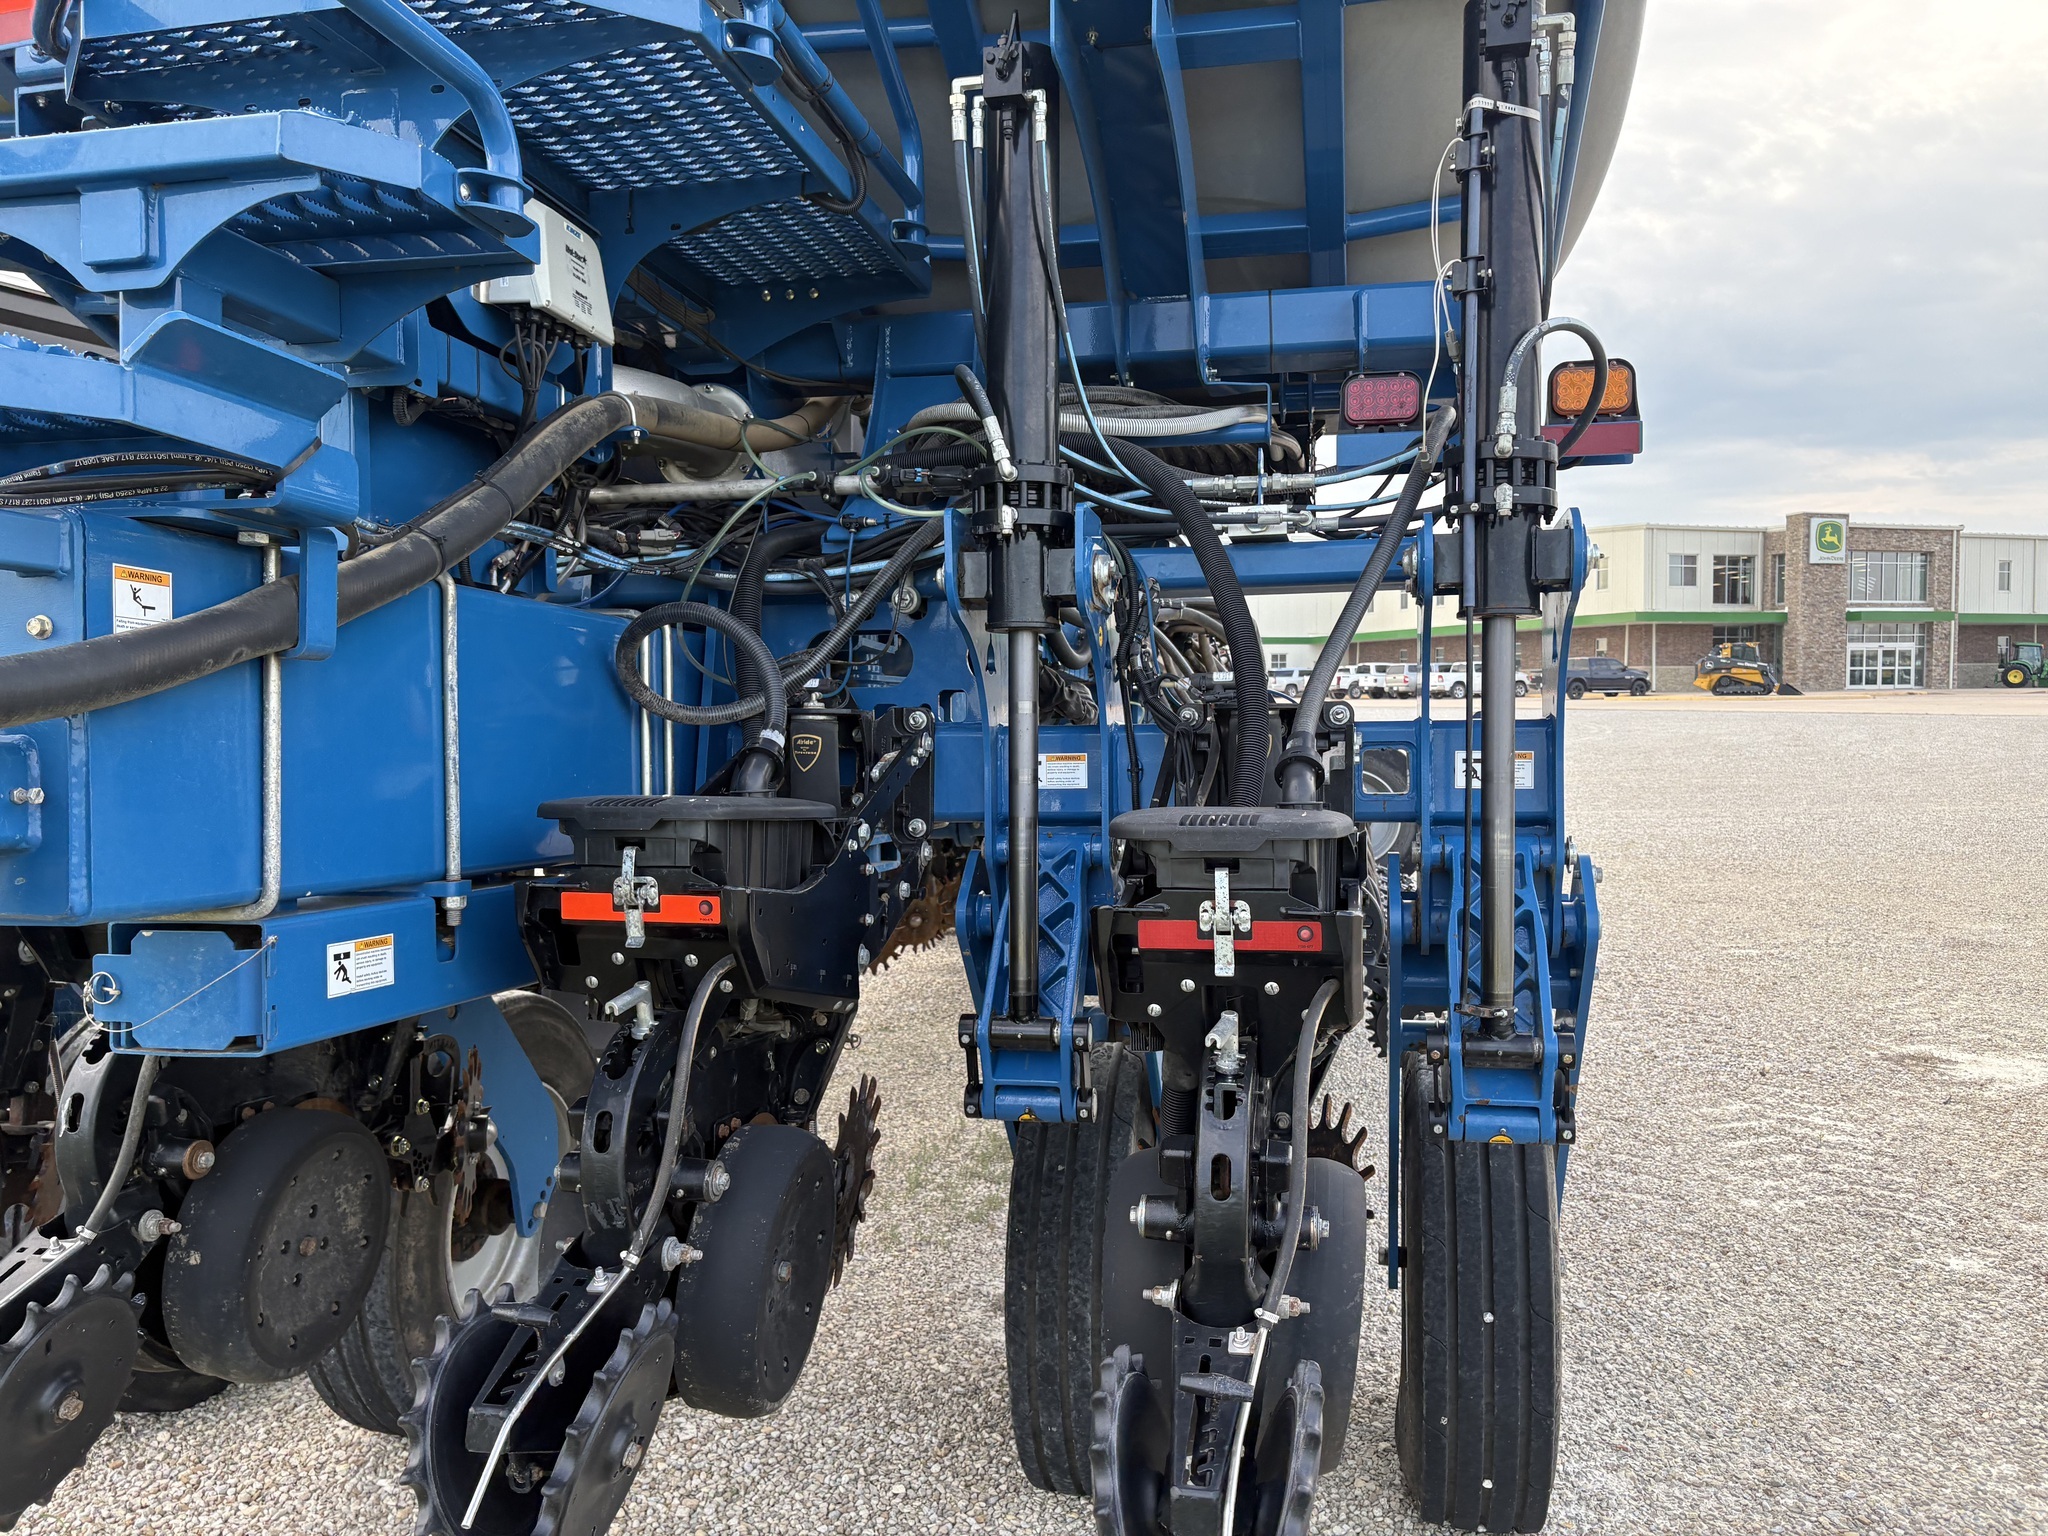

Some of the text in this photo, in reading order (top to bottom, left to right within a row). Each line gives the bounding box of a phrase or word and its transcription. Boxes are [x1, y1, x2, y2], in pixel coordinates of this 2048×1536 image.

[101, 455, 115, 463] SAE
[127, 570, 163, 584] WARNING
[364, 938, 388, 949] WARNING
